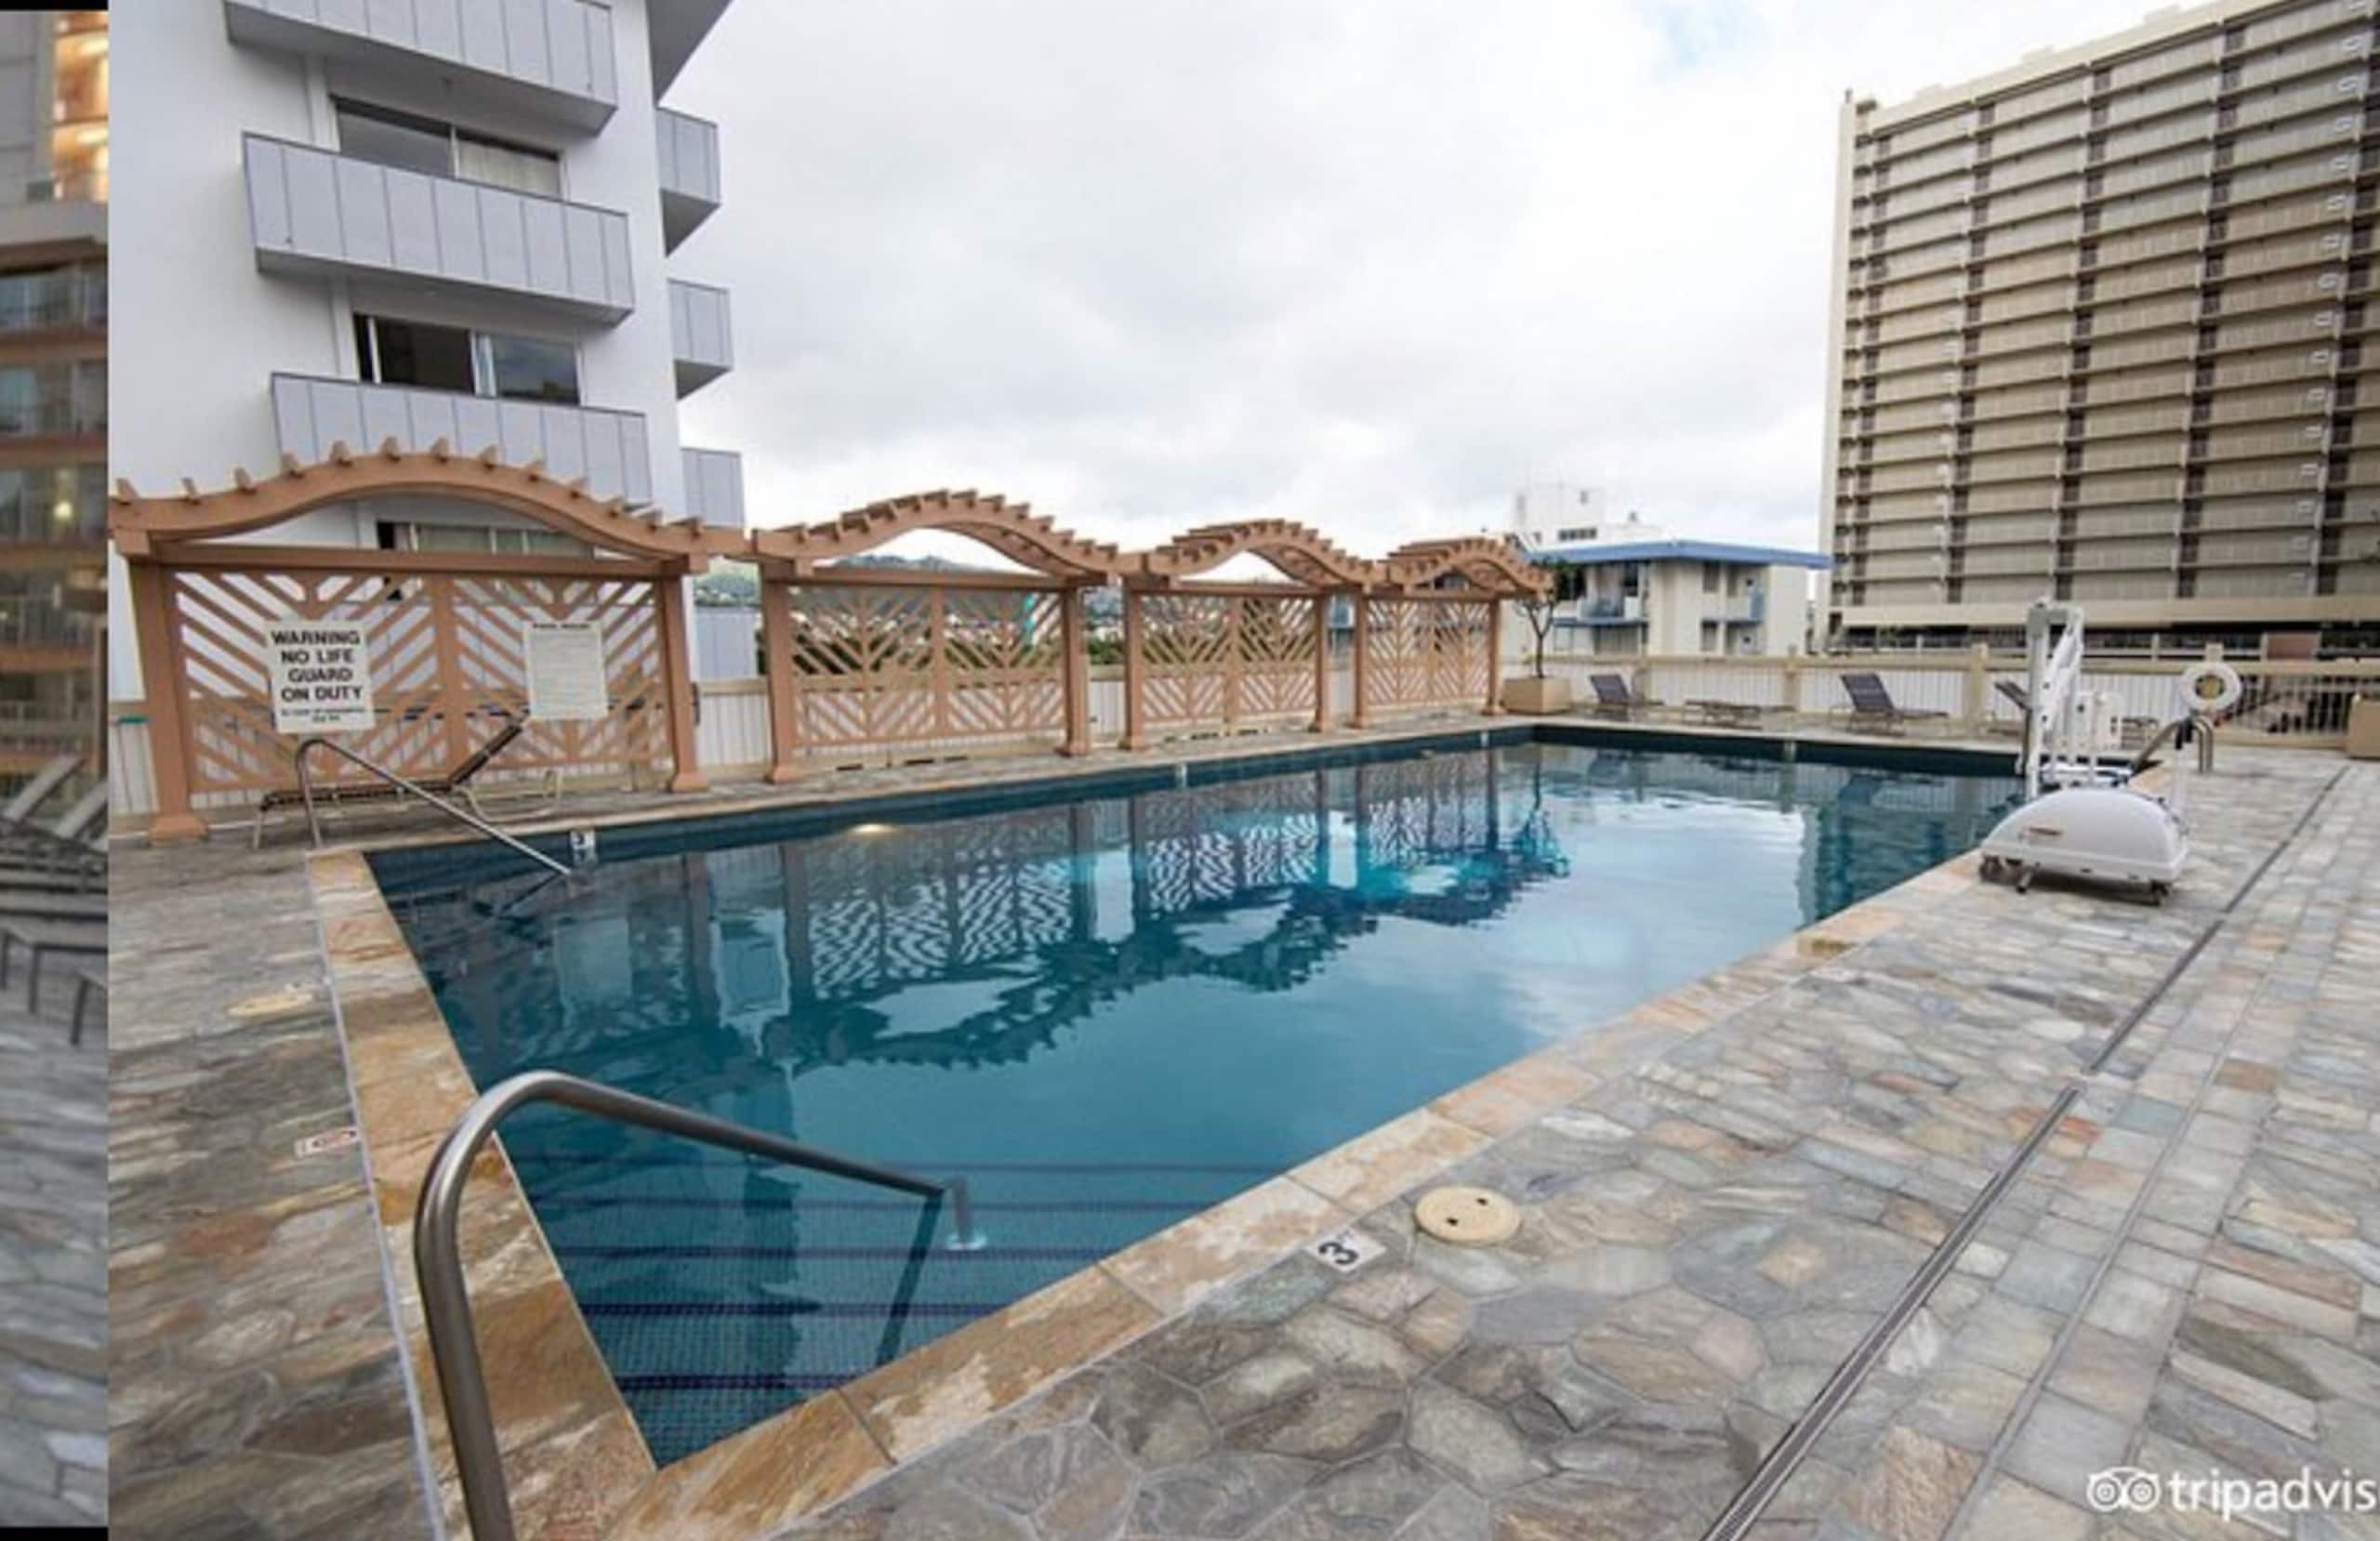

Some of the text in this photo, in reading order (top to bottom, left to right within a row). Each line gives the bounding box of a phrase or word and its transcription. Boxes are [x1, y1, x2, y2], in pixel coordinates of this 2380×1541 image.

[271, 629, 361, 645] WARNING
[281, 648, 355, 665] NO LIFE
[287, 666, 353, 683] GUARD
[281, 685, 363, 703] ON DUTY
[1318, 1241, 1359, 1266] 3
